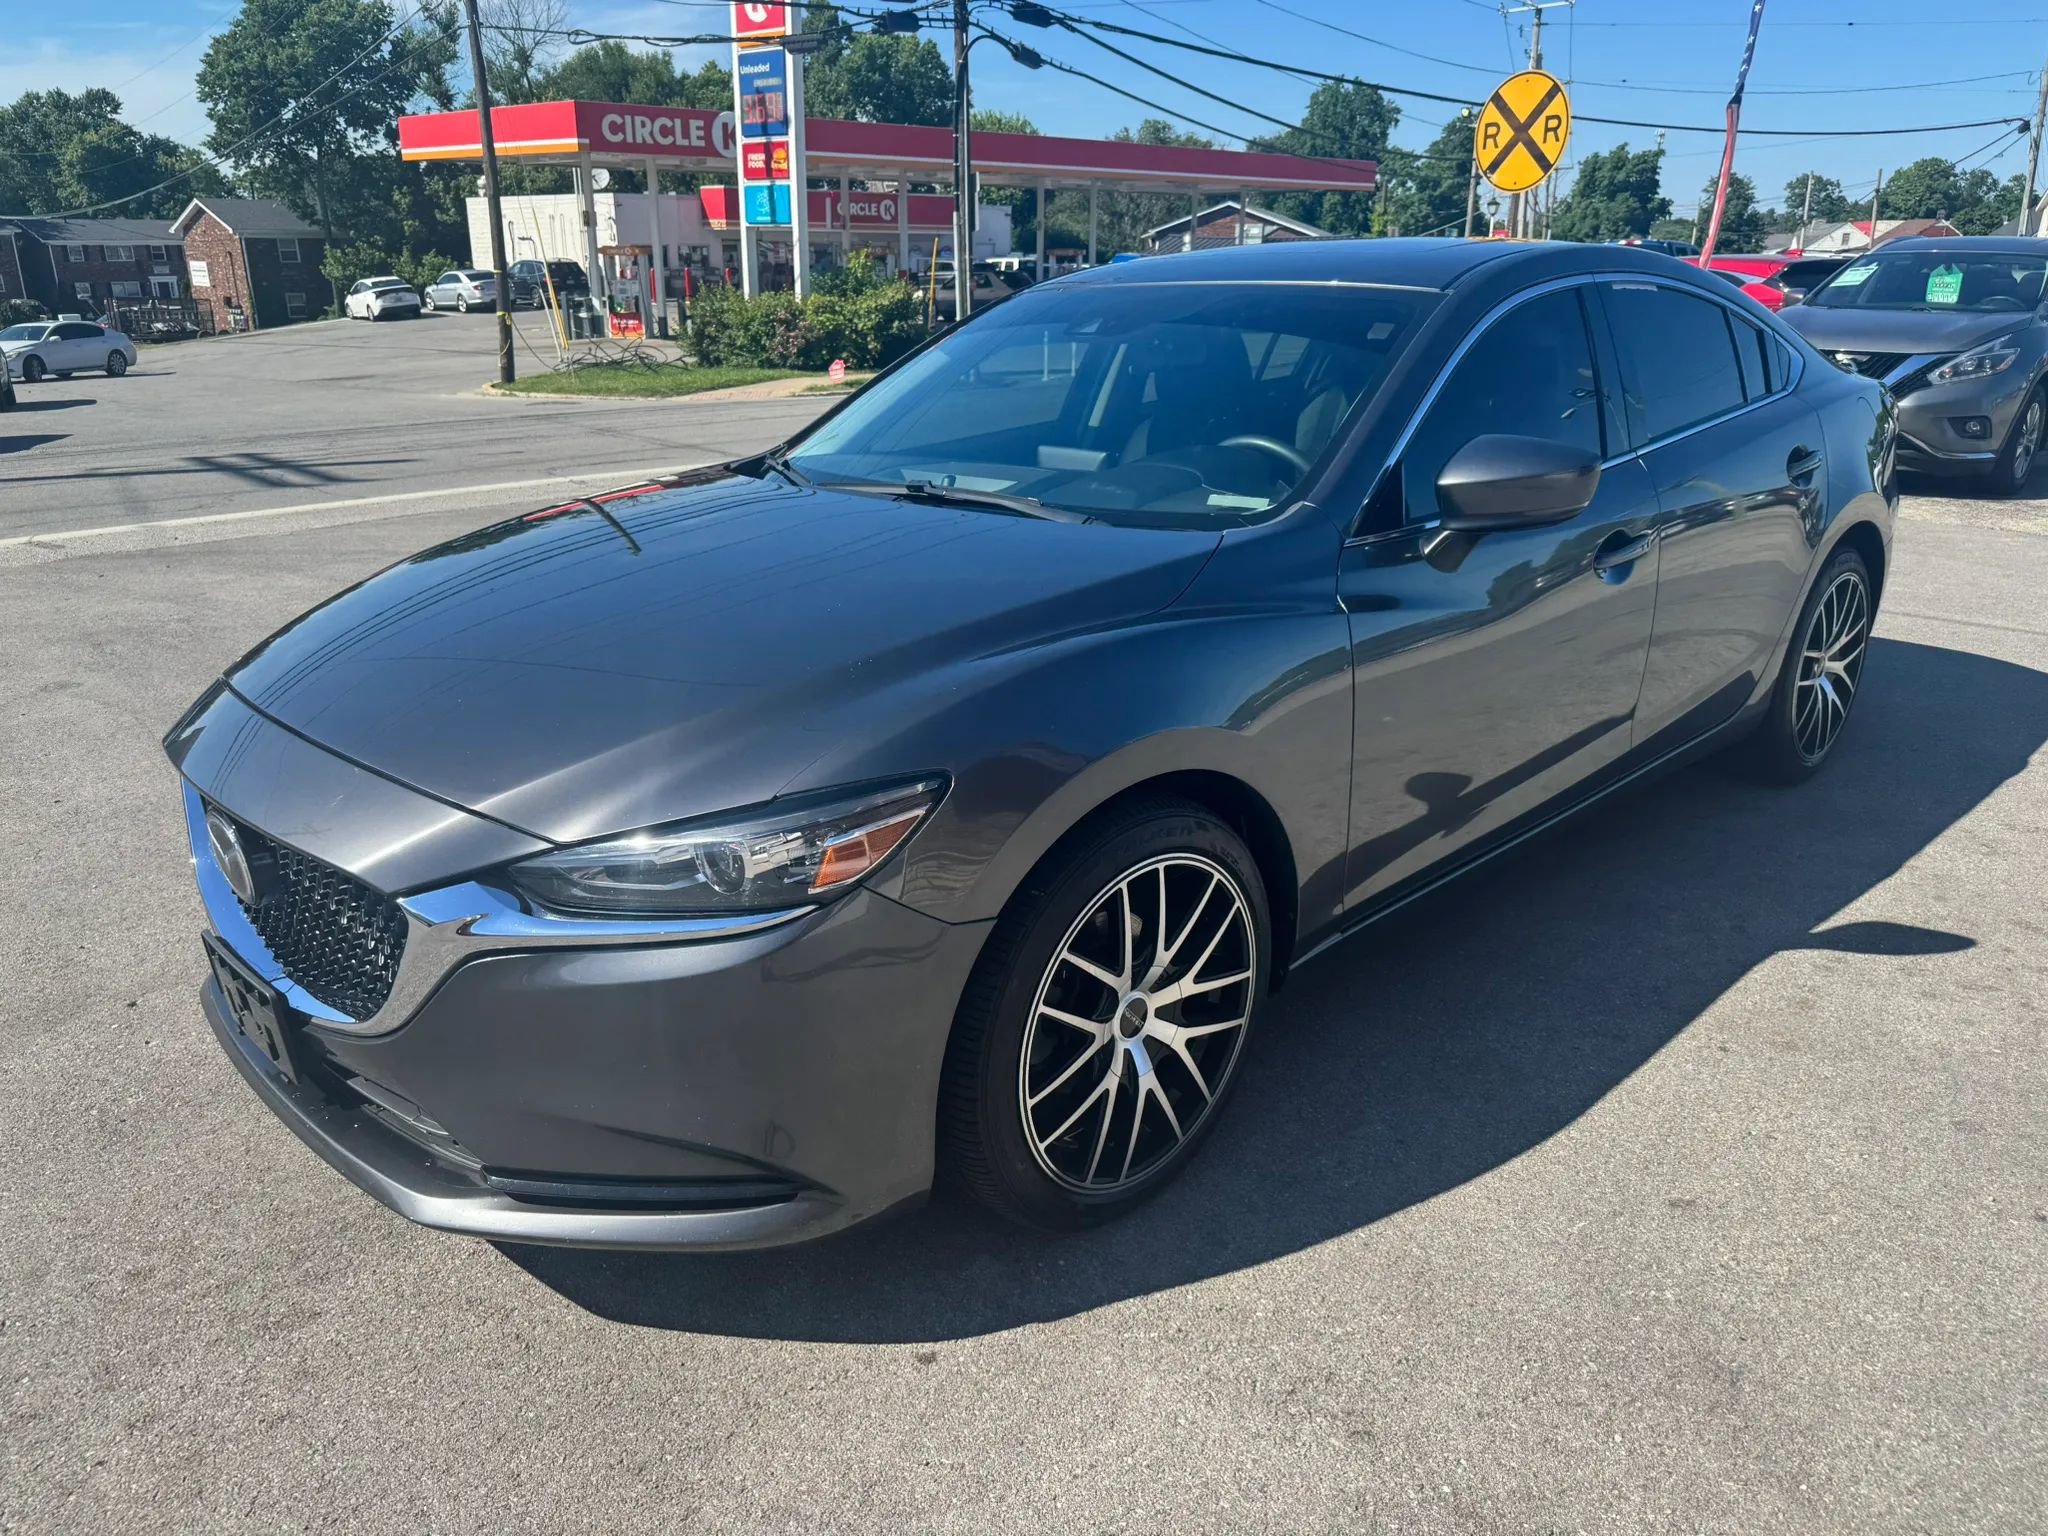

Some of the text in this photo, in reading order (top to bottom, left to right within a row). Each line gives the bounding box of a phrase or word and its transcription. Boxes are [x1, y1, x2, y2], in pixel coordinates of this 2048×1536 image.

[740, 63, 770, 75] Unleaded
[601, 113, 706, 147] CIRCLE
[1482, 114, 1562, 150] R R
